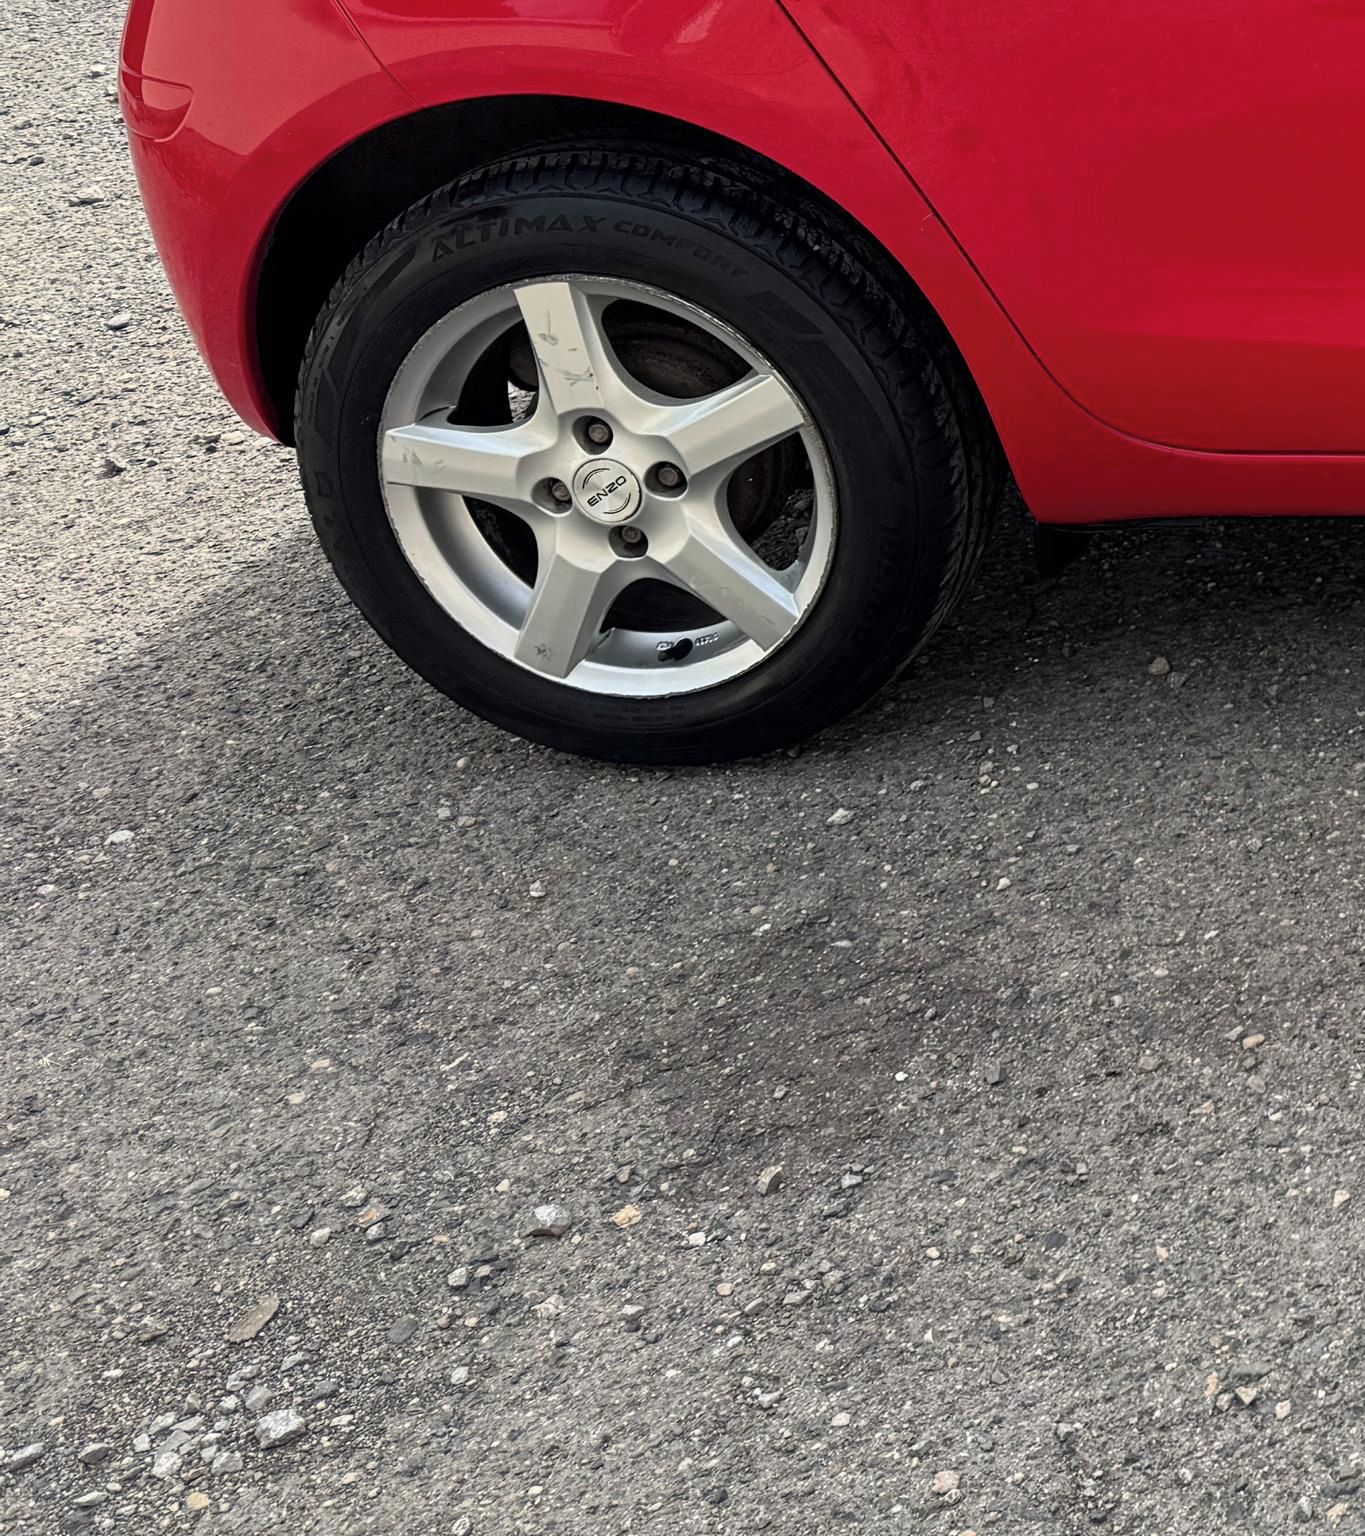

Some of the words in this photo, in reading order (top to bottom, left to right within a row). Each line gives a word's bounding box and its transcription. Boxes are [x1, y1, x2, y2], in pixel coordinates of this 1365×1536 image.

[431, 211, 607, 264] ALTIMAX
[612, 219, 750, 279] COMFORT
[587, 475, 628, 508] ENZO
